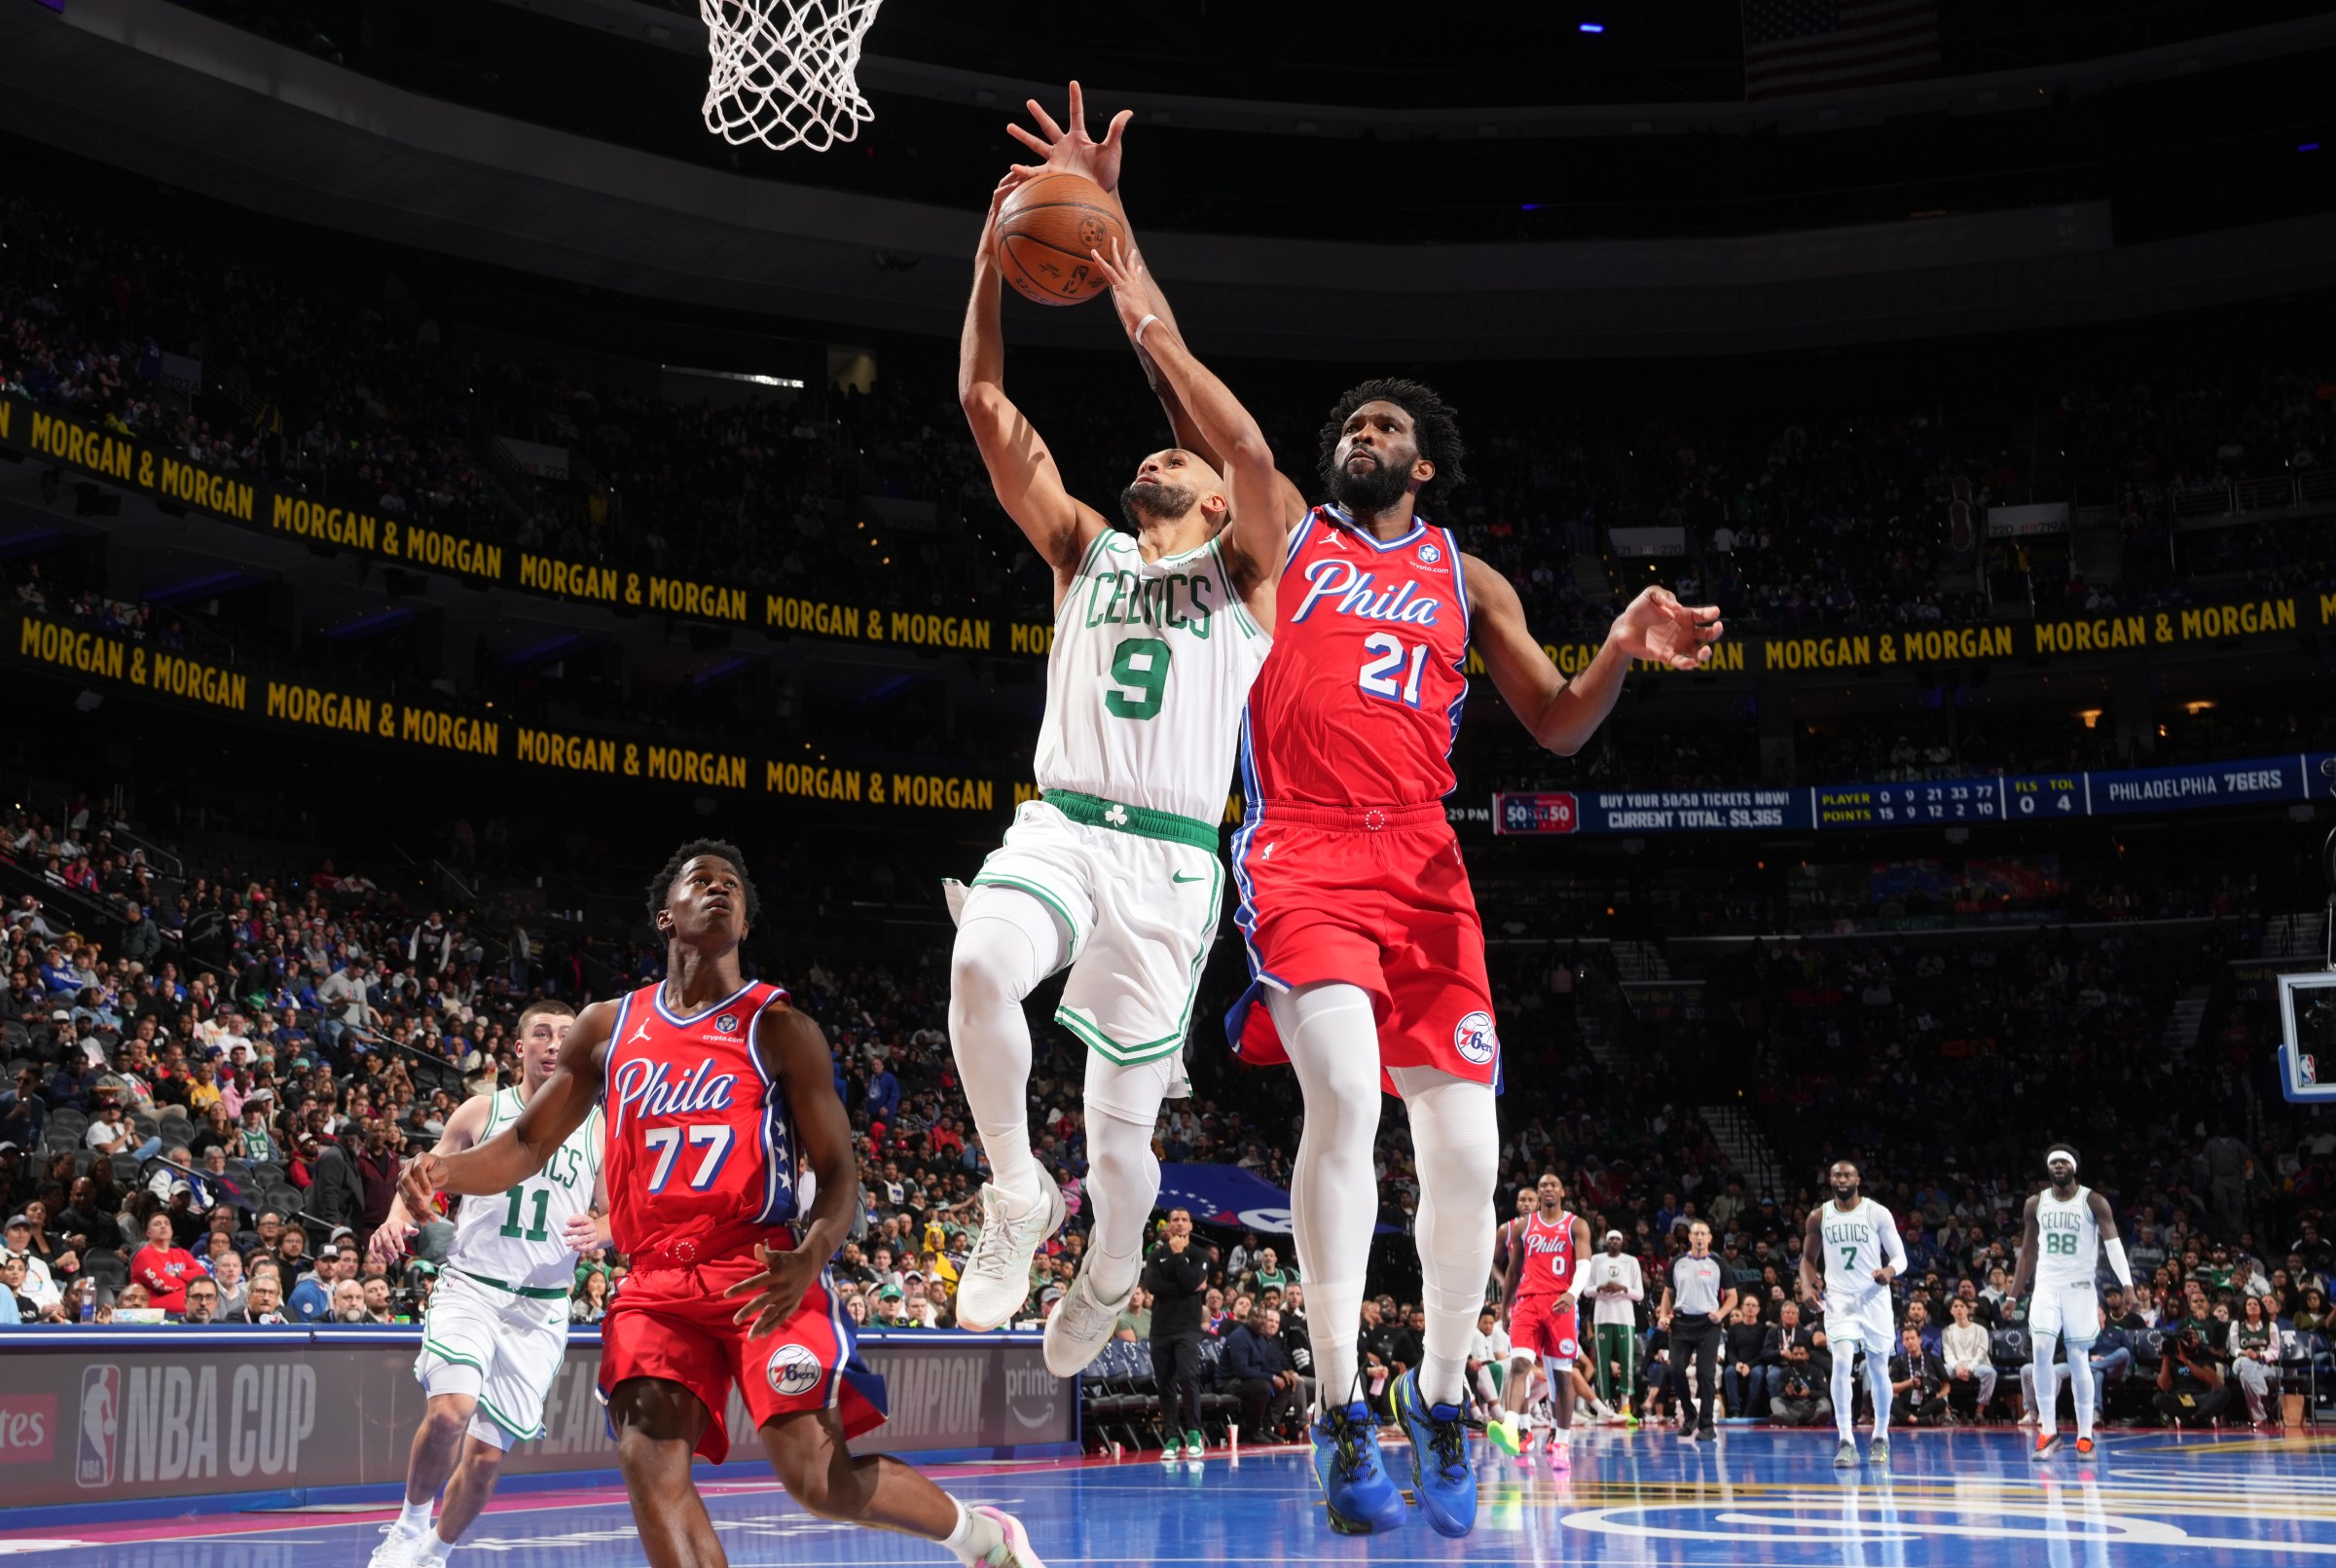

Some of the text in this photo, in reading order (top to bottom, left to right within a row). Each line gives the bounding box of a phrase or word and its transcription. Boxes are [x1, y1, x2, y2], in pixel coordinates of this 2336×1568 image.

[32, 412, 131, 479] MORGAN
[138, 451, 154, 487] &
[162, 457, 253, 520] MORGAN
[274, 494, 501, 578] MORGAN & MORGAN
[521, 554, 747, 620] MORGAN & MORGAN
[1290, 558, 1441, 627] Phila
[1085, 569, 1212, 639] CELTICS
[767, 596, 858, 638] MORGAN
[866, 609, 883, 639] &
[892, 612, 990, 649] MORGAN
[2035, 616, 2145, 652] MORGAN
[2155, 613, 2173, 642] &
[2181, 600, 2295, 639] MORGAN
[1766, 627, 2012, 669] MORGAN & MORGAN
[21, 617, 245, 710] MORGAN & MORGAN
[1358, 631, 1430, 709] 21
[1105, 638, 1172, 720] 9
[267, 682, 498, 755] MORGAN & MORGAN
[518, 728, 747, 788] MORGAN & MORGAN
[767, 761, 860, 801] MORGAN
[868, 773, 885, 803] &
[894, 774, 993, 810] MORGAN
[1600, 791, 1790, 808] BUY YOUR 50/50 TICKETS NOW!
[1822, 785, 1992, 806] PLAYER 0 9 21 33 77
[2015, 779, 2075, 793] FLS TOL
[2108, 769, 2282, 802] PHILADELPHIA 76ERS
[1467, 808, 1489, 820] PM
[1506, 805, 1527, 822] 50
[1549, 805, 1570, 821] 50
[1823, 802, 1993, 822] POINTS 15 9 12 2 10
[2020, 793, 2072, 814] 0 4
[1608, 812, 1674, 828] CURRENT
[1678, 811, 1726, 827] TOTAL:
[2235, 986, 2258, 1002] 120
[702, 1034, 745, 1044] crypto.com
[1459, 1027, 1493, 1054] 76ers
[615, 1058, 739, 1139] Phila
[645, 1124, 736, 1194] 77
[499, 1185, 550, 1242] 11
[2041, 1211, 2081, 1232] CELTICS
[1527, 1233, 1567, 1258] Phila
[1824, 1223, 1870, 1245] CELTICS
[2046, 1233, 2077, 1256] 88
[1551, 1256, 1567, 1276] 0
[1841, 1246, 1858, 1271] 7
[774, 1363, 818, 1385] 76ers
[1004, 1361, 1059, 1404] prime
[123, 1364, 317, 1482] NBA CUP
[81, 1462, 101, 1479] NBA
